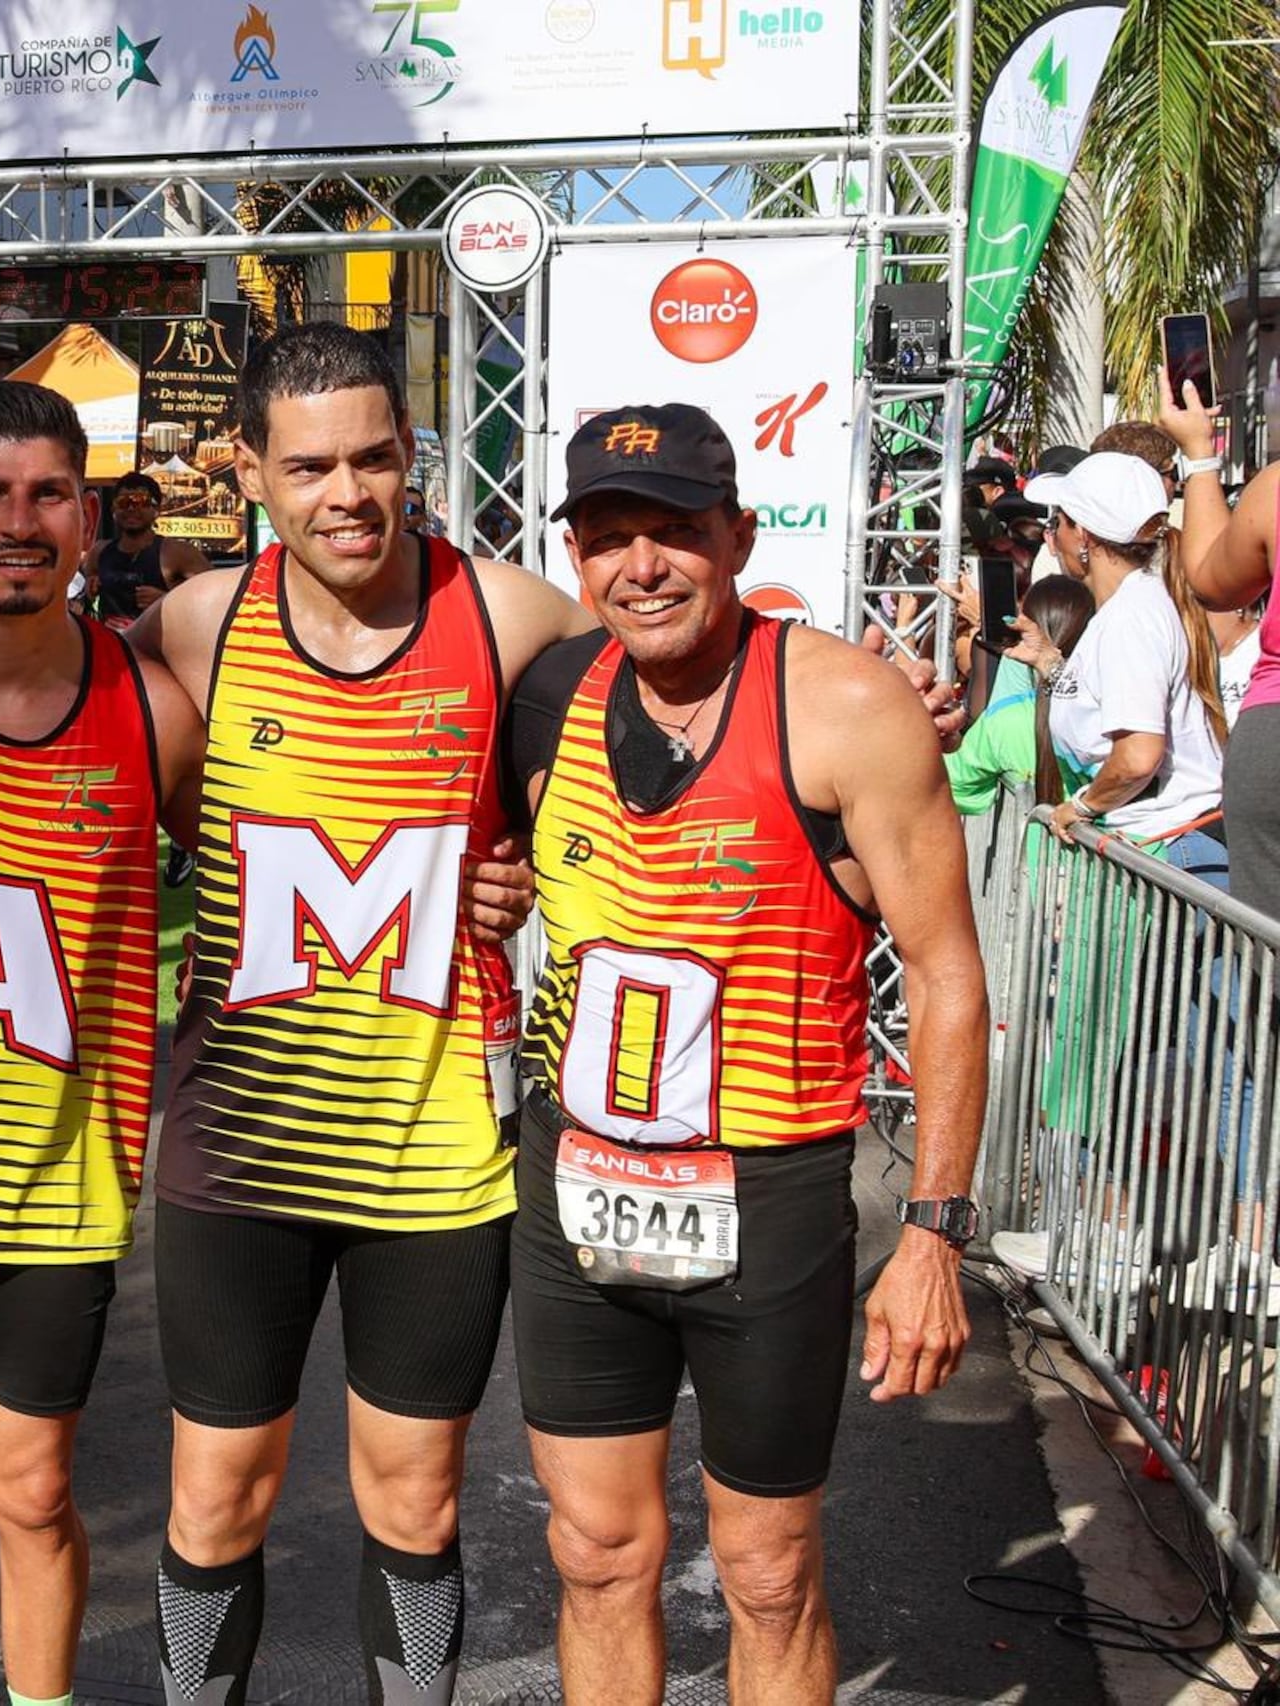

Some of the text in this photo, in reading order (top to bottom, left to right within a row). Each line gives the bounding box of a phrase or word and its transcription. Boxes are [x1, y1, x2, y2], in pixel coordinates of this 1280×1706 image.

[739, 7, 823, 36] hello
[94, 36, 112, 48] DE
[758, 37, 804, 49] MEDIA
[4, 77, 112, 95] PUERTO RICO
[461, 221, 514, 237] SAN
[459, 235, 528, 251] BLAS
[657, 298, 738, 325] Claro
[177, 335, 214, 368] AD
[160, 387, 227, 404] De todo para
[161, 401, 224, 414] su actividad
[754, 382, 829, 458] K
[160, 521, 232, 535] 787-505-1331
[223, 810, 469, 1020] M
[574, 1148, 698, 1182] SANBLAS
[580, 1187, 705, 1255] 3644
[716, 1213, 731, 1257] CORRAL
